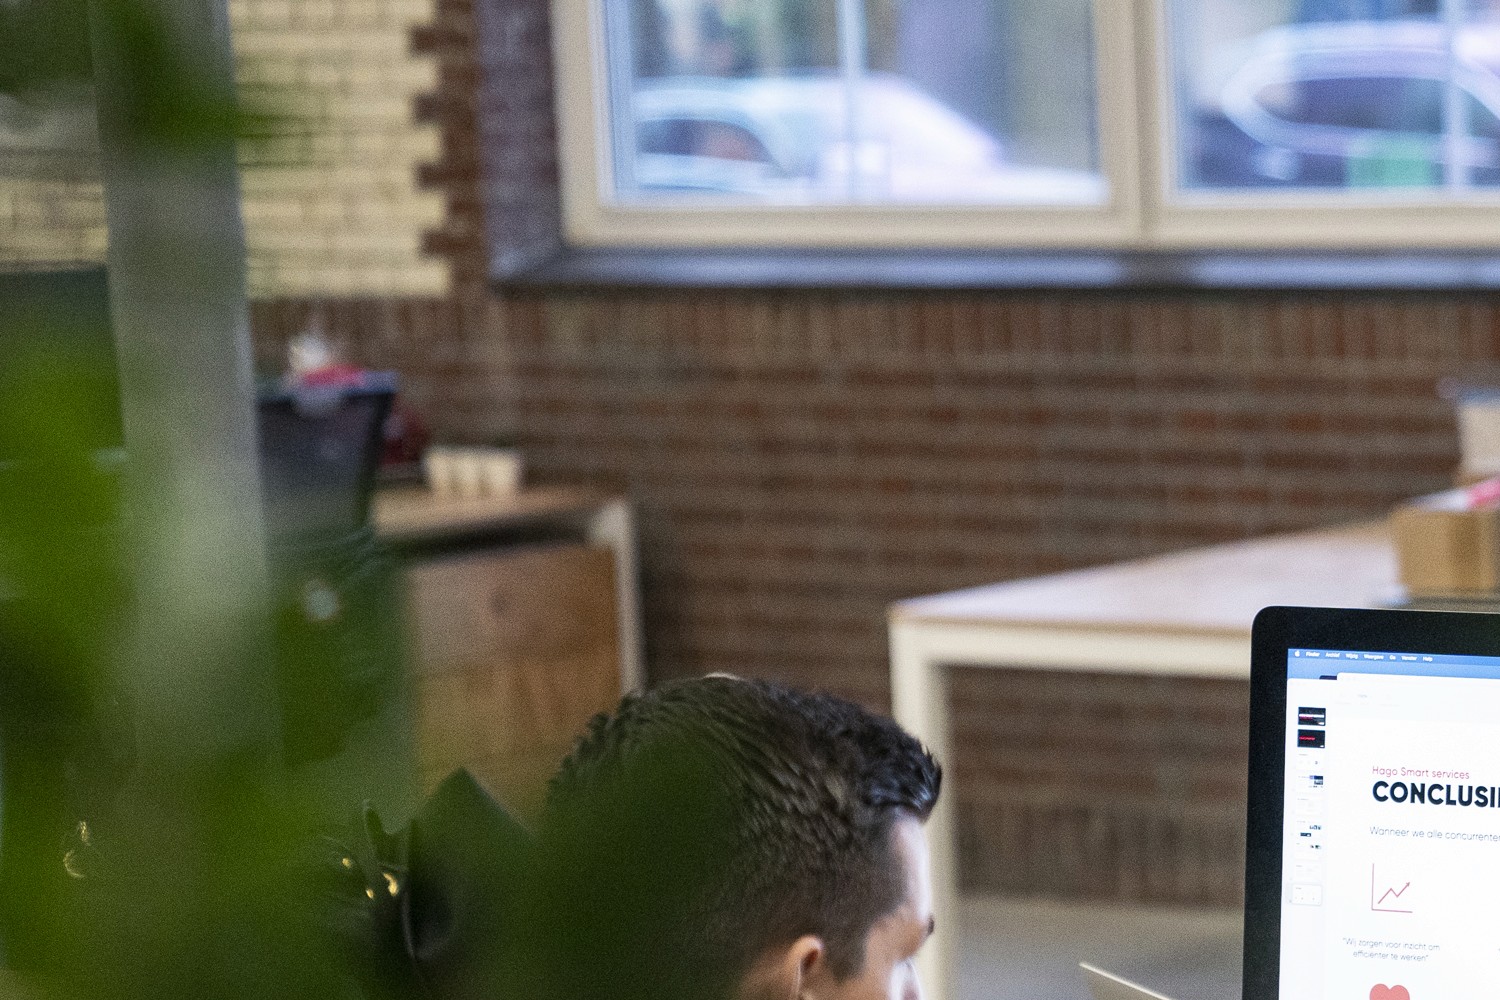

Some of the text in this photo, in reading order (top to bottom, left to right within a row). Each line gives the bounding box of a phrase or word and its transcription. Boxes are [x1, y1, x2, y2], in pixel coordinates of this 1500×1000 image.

[1372, 766, 1470, 780] Hago Smart services
[1370, 826, 1410, 837] Wanneer
[1411, 829, 1425, 838] we
[1426, 828, 1443, 839] alle
[1358, 940, 1383, 951] zorgen
[1384, 942, 1402, 950] voor
[1402, 941, 1427, 952] inzicht
[1390, 952, 1399, 960] te
